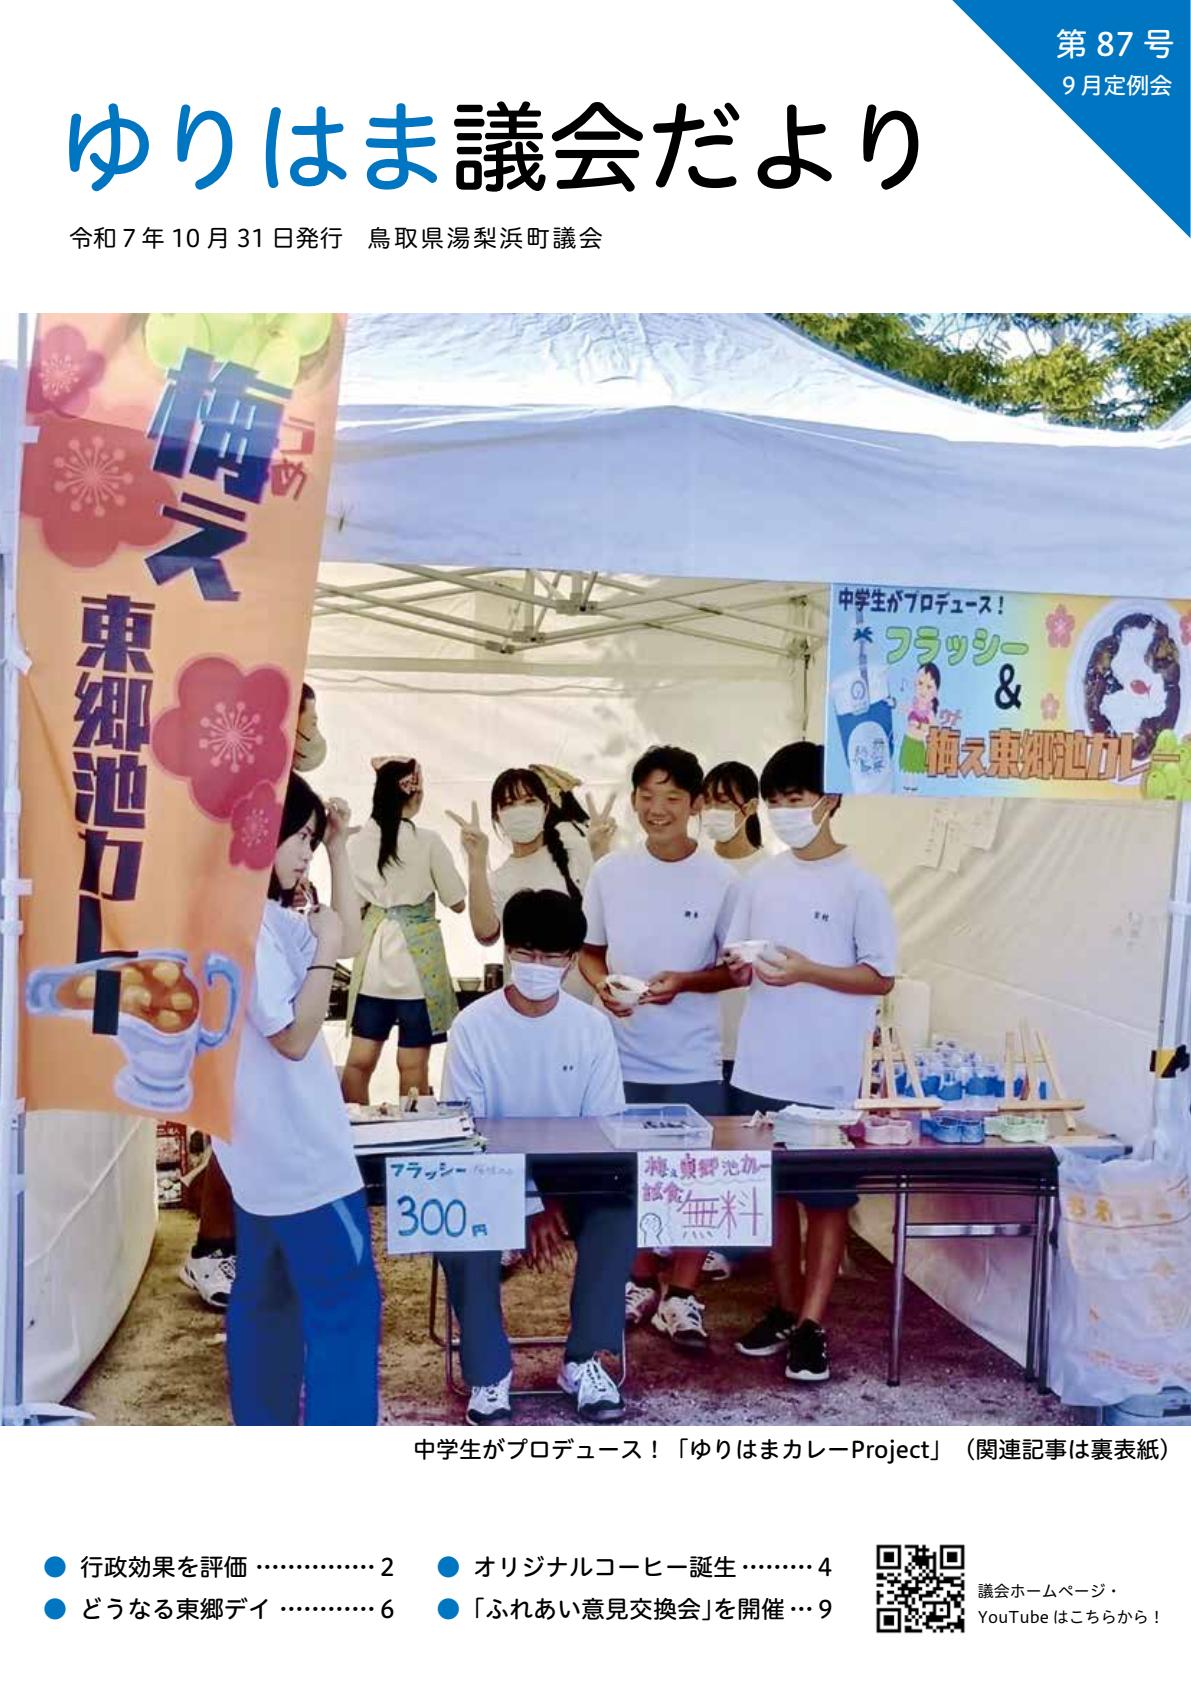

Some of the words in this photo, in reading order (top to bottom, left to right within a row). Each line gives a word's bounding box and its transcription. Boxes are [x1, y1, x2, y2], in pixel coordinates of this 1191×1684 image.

[838, 586, 1005, 615] 中学生がプロデュース！
[885, 625, 1030, 667] フラッシー
[994, 663, 1022, 711] &
[72, 594, 156, 1036] 東郷池カレー
[390, 1162, 467, 1180] フラッシー
[677, 1186, 764, 1239] 無料
